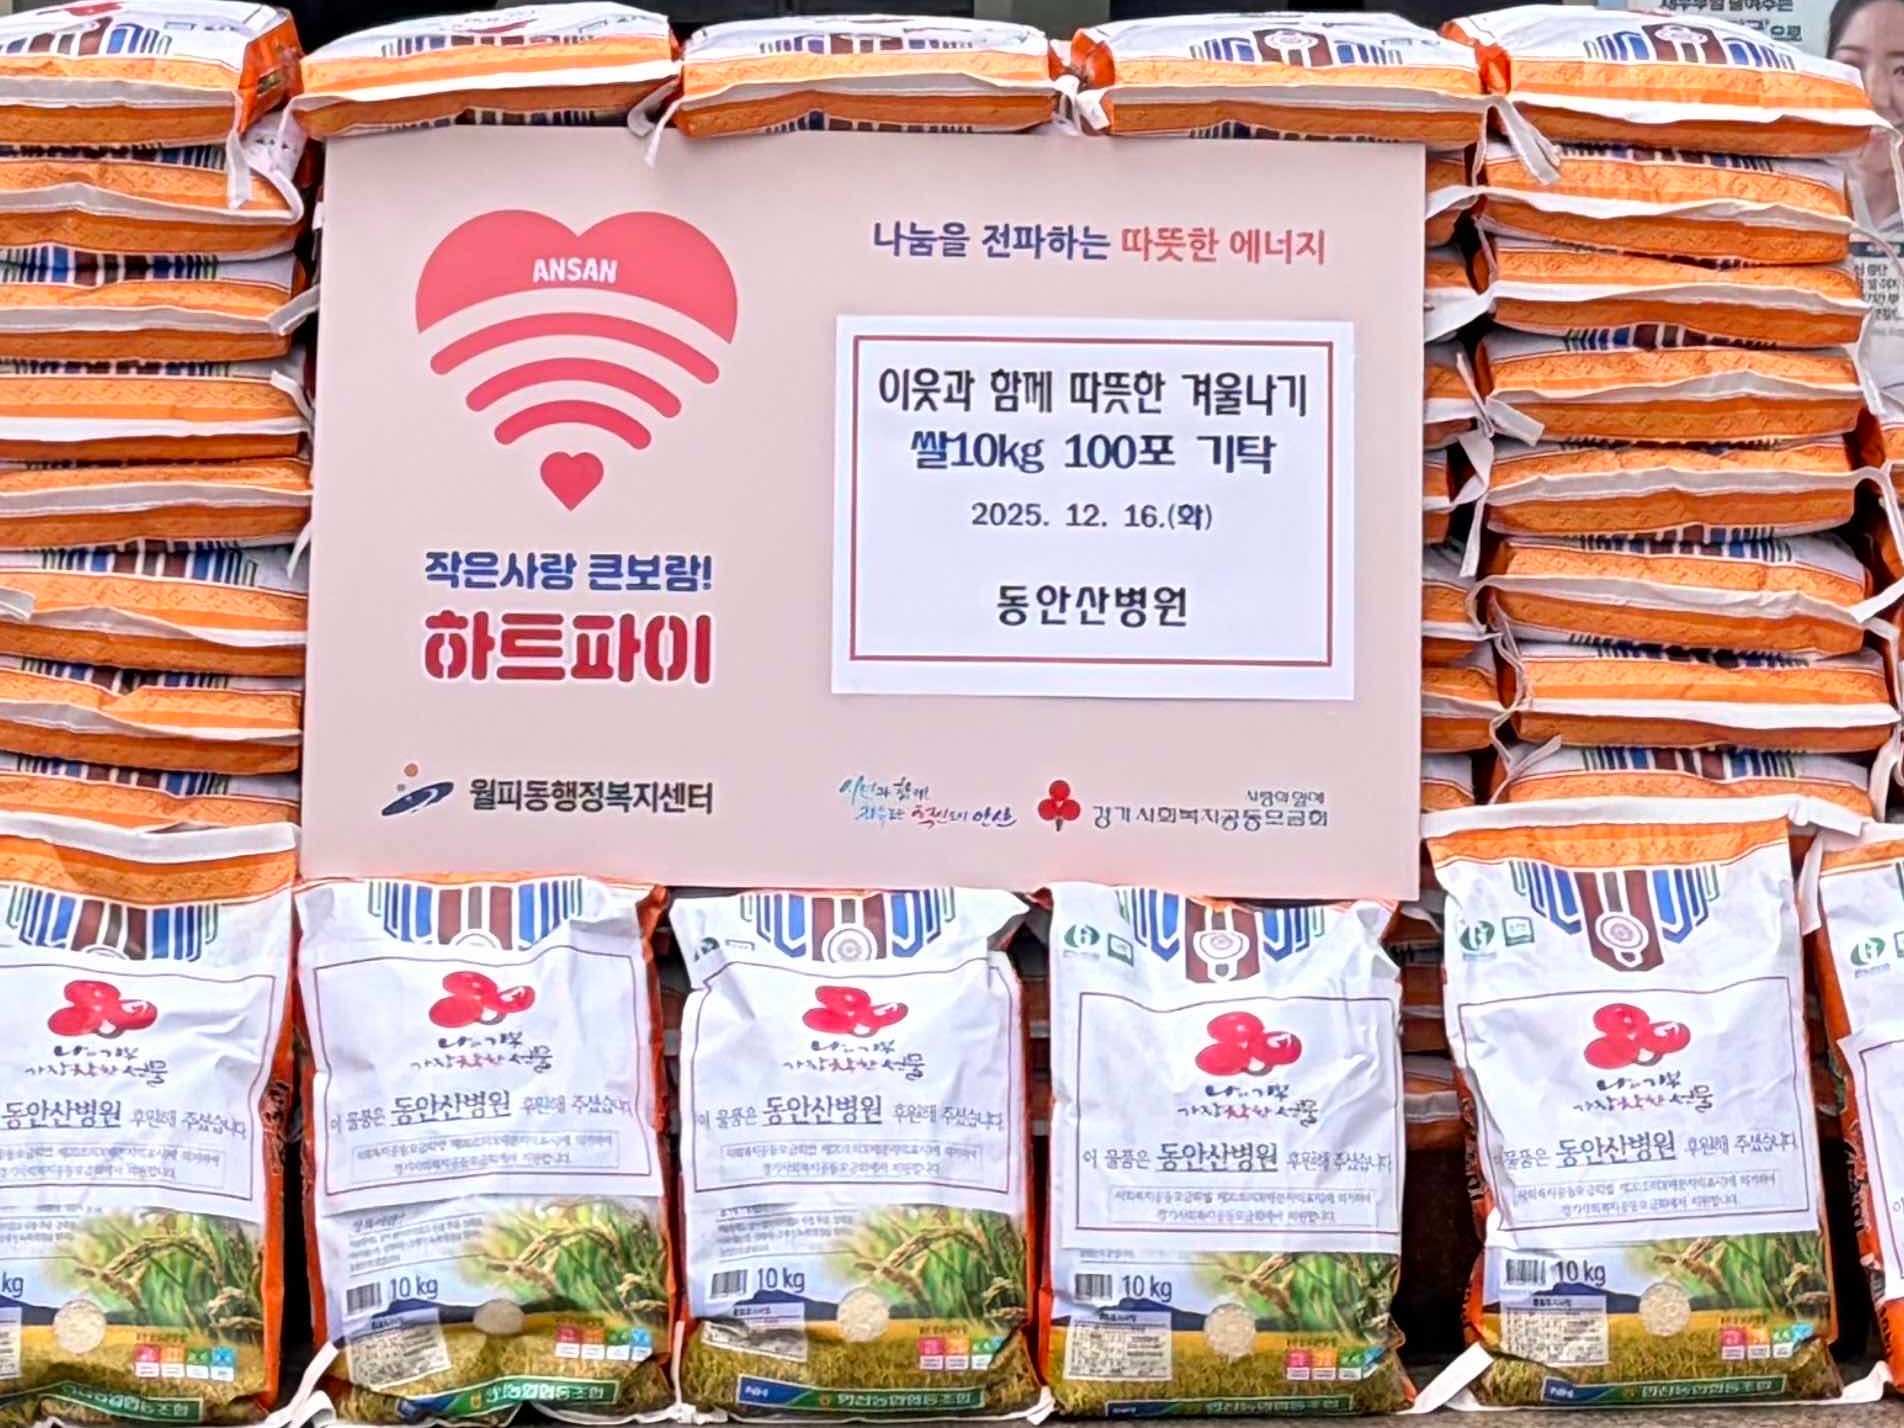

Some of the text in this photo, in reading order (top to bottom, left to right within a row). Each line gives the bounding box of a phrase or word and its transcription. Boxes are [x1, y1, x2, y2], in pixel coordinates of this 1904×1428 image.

[873, 220, 1326, 265] 나눔을 전파하는 따뜻한 에너지
[533, 258, 619, 284] ANSAN
[879, 368, 1307, 416] 이웃과 함께 따뜻한 겨울나기
[911, 430, 1277, 474] 쌀10kg 100포 기탁
[971, 501, 1213, 530] 2025. 12. 16.(화)
[425, 551, 712, 592] 작은사랑 큰보람!
[997, 584, 1188, 628] 동안산병원
[424, 609, 712, 684] 하트파이
[469, 778, 1329, 832] 월피동행정복지센터 경기사회복지공동모금회
[973, 806, 1018, 828] 안산
[0, 1099, 122, 1130] 동안산병원
[391, 1089, 511, 1126] 동안산병원
[763, 1095, 883, 1126] 동안산병원
[1155, 1142, 1278, 1173] 동안산병원
[1556, 1129, 1677, 1168] 동안산병원
[2, 1272, 24, 1298] kg
[390, 1275, 439, 1301] 10 kg
[757, 1267, 805, 1293] 10 kg
[1557, 1259, 1606, 1286] 10 kg
[1122, 1275, 1172, 1302] 10 kg
